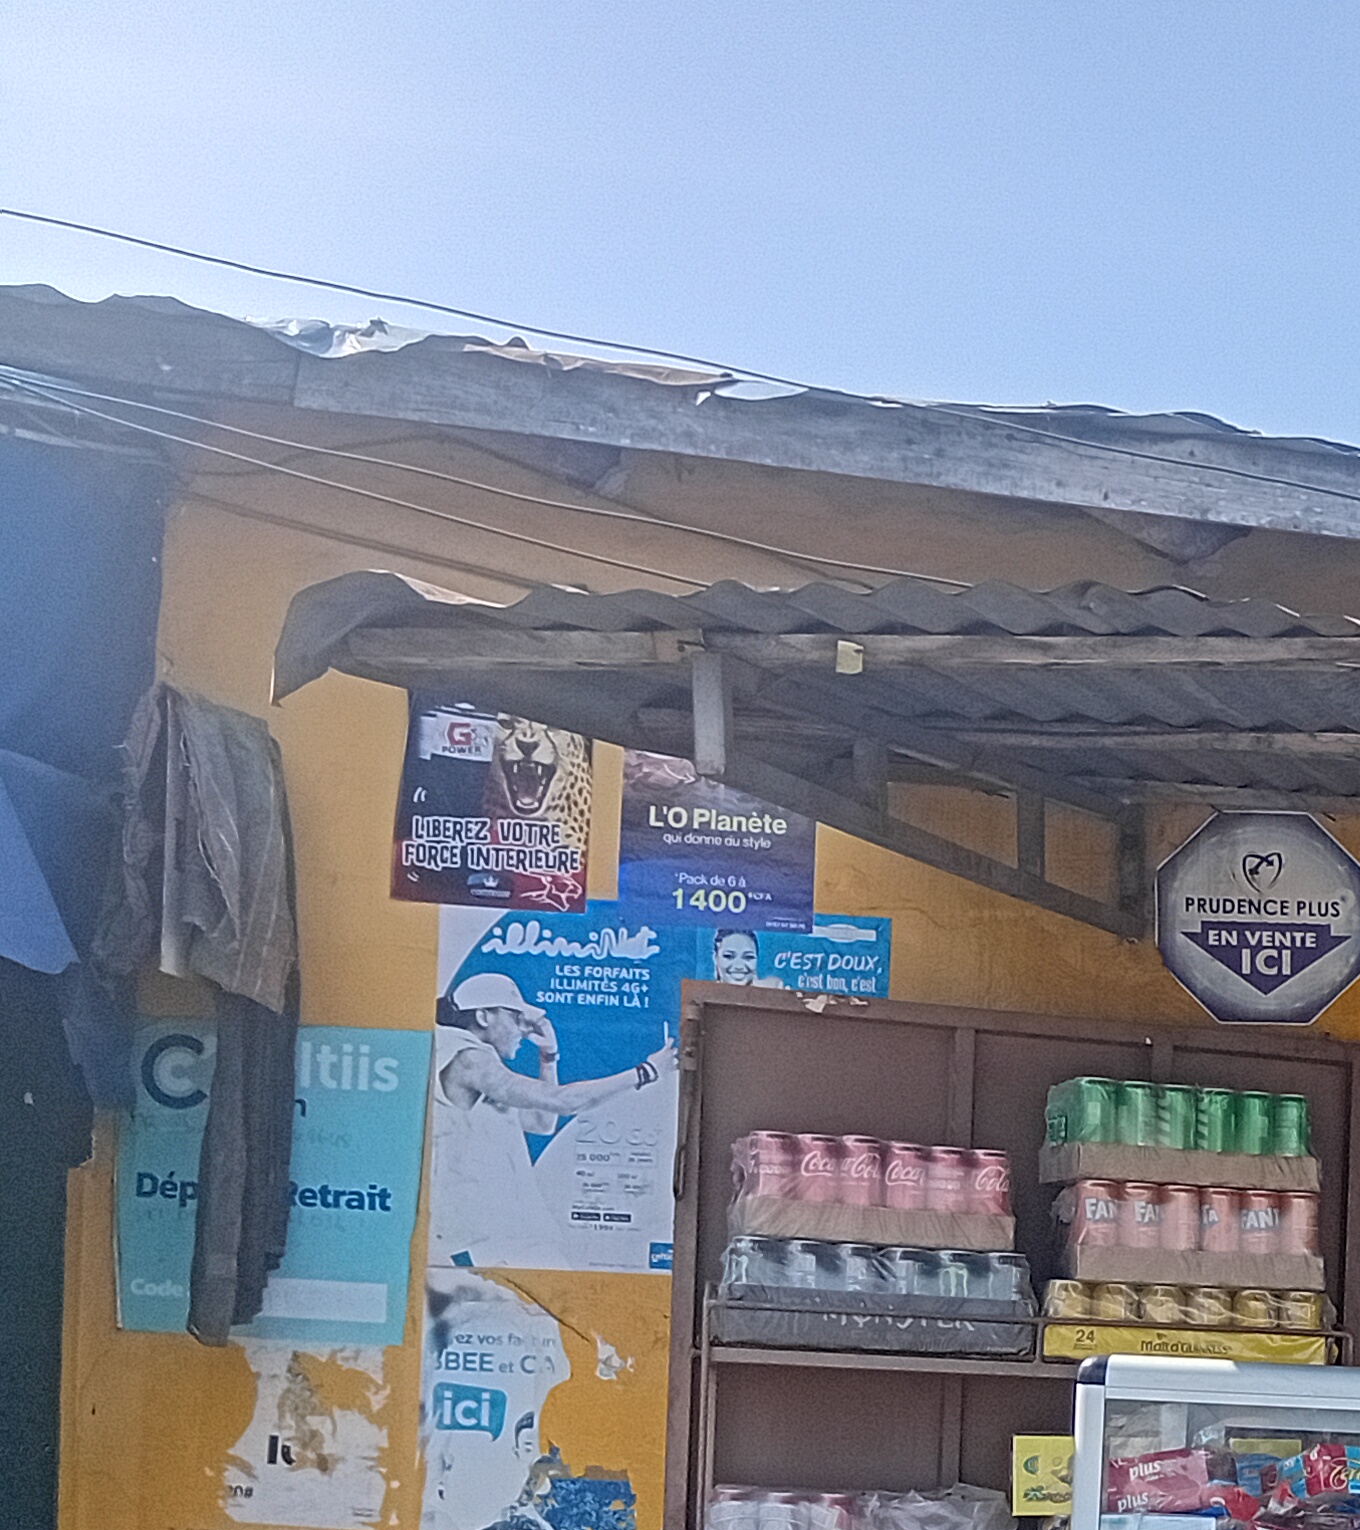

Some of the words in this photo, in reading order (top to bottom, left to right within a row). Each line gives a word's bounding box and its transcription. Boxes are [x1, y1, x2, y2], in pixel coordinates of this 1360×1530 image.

[441, 745, 481, 754] POWER
[649, 806, 688, 829] L'O
[692, 808, 788, 836] Planète
[413, 816, 490, 843] LIBEREZ
[499, 819, 561, 848] VOTRE
[663, 833, 682, 845] qui
[743, 834, 772, 850] style
[403, 842, 460, 870] FORCE
[468, 846, 581, 873] INTERIEURE
[710, 873, 726, 886] de
[672, 887, 747, 914] 1400
[1185, 896, 1290, 917] PRUDENCE
[1297, 900, 1341, 919] PLUS
[1207, 928, 1240, 946] EN
[1244, 930, 1317, 948] VENTE
[774, 952, 822, 969] C'EST
[1240, 948, 1292, 976] ICI
[555, 965, 581, 978] LES
[584, 966, 650, 981] FORFAITS
[621, 981, 649, 993] 4G+
[536, 991, 574, 1004] SONT
[576, 993, 620, 1006] ENFIN
[136, 1171, 198, 1208] Dép
[1085, 1197, 1116, 1221] FAN
[1240, 1208, 1279, 1230] FANT
[130, 1278, 184, 1297] Code
[1075, 1329, 1096, 1343] 24
[499, 1361, 515, 1373] et
[442, 1390, 491, 1427] ici
[1129, 1459, 1162, 1481] plus
[1117, 1491, 1149, 1512] plus
